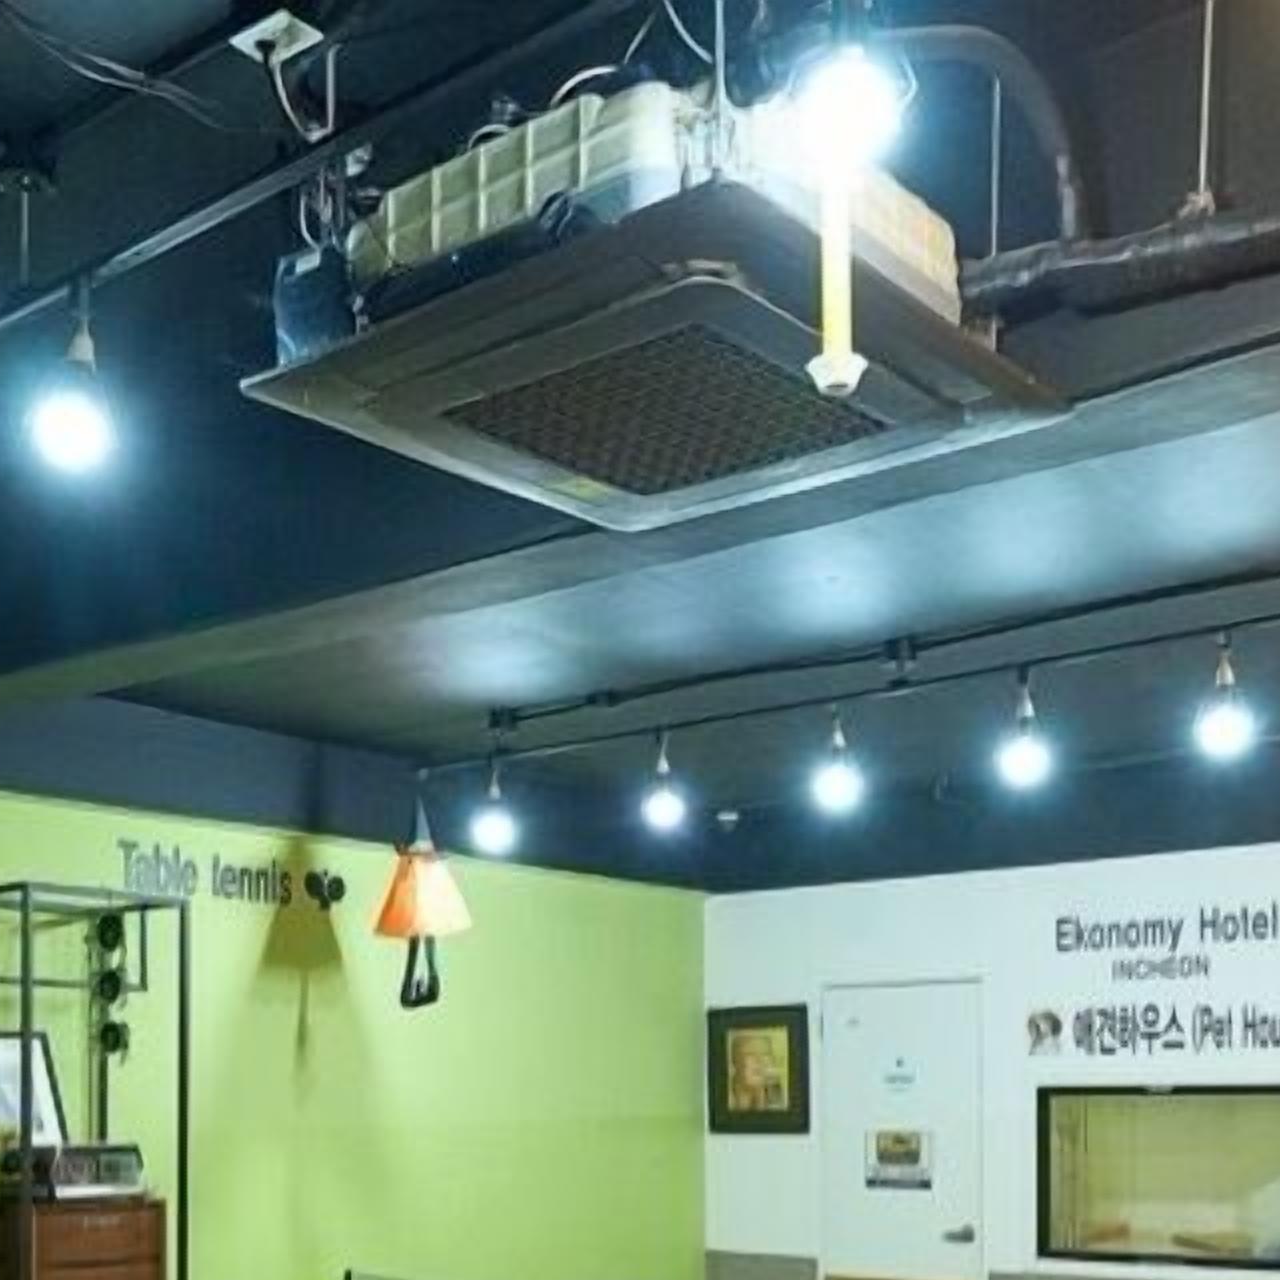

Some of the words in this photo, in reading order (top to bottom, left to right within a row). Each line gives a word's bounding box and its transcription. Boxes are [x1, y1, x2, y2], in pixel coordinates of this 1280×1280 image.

[117, 838, 198, 897] Table
[212, 853, 293, 906] tennis
[1055, 916, 1184, 953] Ekonomy
[1199, 903, 1278, 943] Hotel
[1111, 955, 1210, 981] INCHEON
[1192, 1003, 1232, 1052] (Pet
